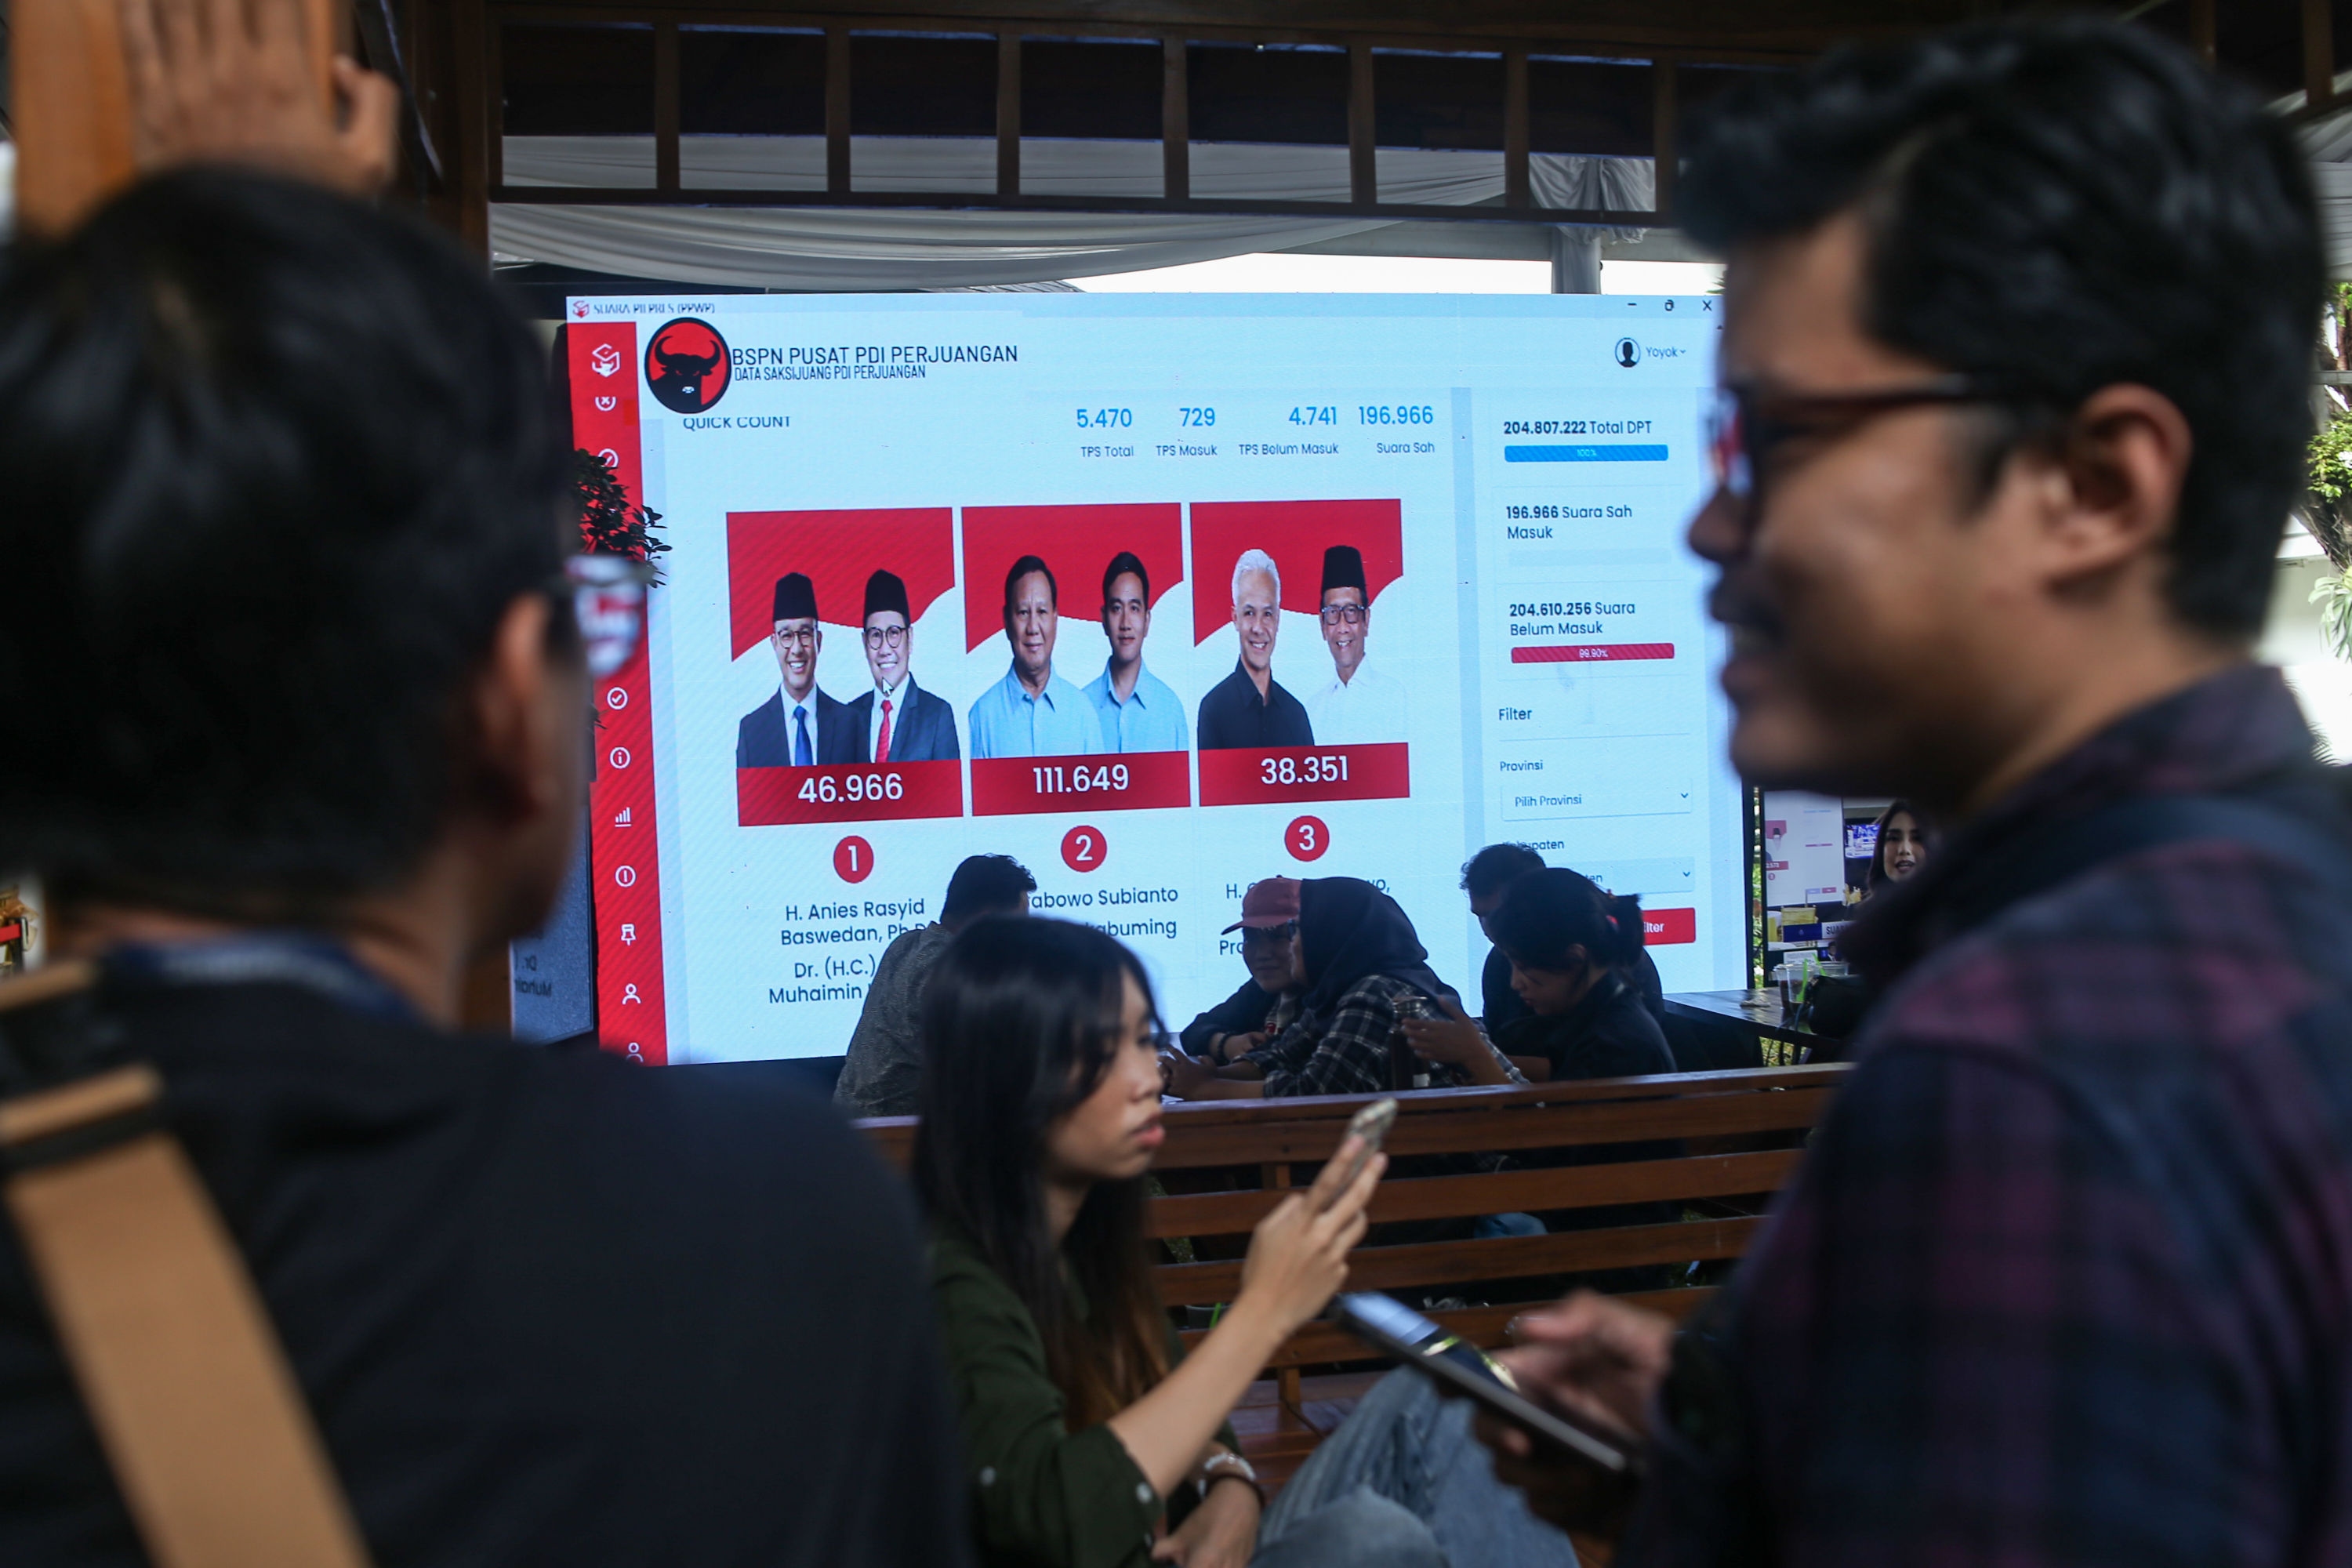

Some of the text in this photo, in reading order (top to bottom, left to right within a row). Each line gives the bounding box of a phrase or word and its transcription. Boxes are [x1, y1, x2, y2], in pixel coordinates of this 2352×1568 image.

[732, 345, 1018, 365] BSPN PUSAT PDI PERJUANGAN
[1646, 346, 1678, 360] Yoyok
[735, 365, 926, 381] DATA SAKSIJUANG PDI PERJUANGAN
[1076, 408, 1132, 428] 5.470
[1179, 407, 1216, 426] 729
[1288, 406, 1337, 426] 4.741
[1359, 405, 1434, 425] 196.966
[683, 416, 791, 431] QUICK COUNT
[1504, 421, 1652, 434] 204.807.222 Total DPT
[1080, 446, 1134, 457] TPS Total
[1156, 445, 1218, 456] TPS Masuk
[1239, 443, 1339, 456] TPS Belum Masuk
[1377, 442, 1435, 453] Suara Sah
[1577, 448, 1597, 457] 100%
[1506, 504, 1632, 519] 196.966 Suara Sah
[1507, 526, 1553, 539] Masuk
[1509, 601, 1635, 617] 204.610.256 Suara
[1511, 621, 1603, 636] Belum Masuk
[1498, 708, 1532, 720] Filter
[1261, 755, 1349, 785] 38.351
[1500, 760, 1544, 771] Provinsi
[1033, 764, 1129, 793] 111.649
[798, 773, 903, 804] 46.966
[1515, 794, 1582, 807] Pilih Provinsi
[1298, 824, 1316, 851] 3
[1075, 834, 1093, 862] 2
[848, 845, 858, 872] 1
[1029, 887, 1178, 908] abowo Subianto
[1226, 884, 1242, 899] H.
[786, 898, 925, 921] H. Anies Rasyid
[781, 926, 883, 946] Baswedan,
[794, 953, 876, 979] Dr. (H.C.)
[769, 983, 862, 1004] Muhaimin
